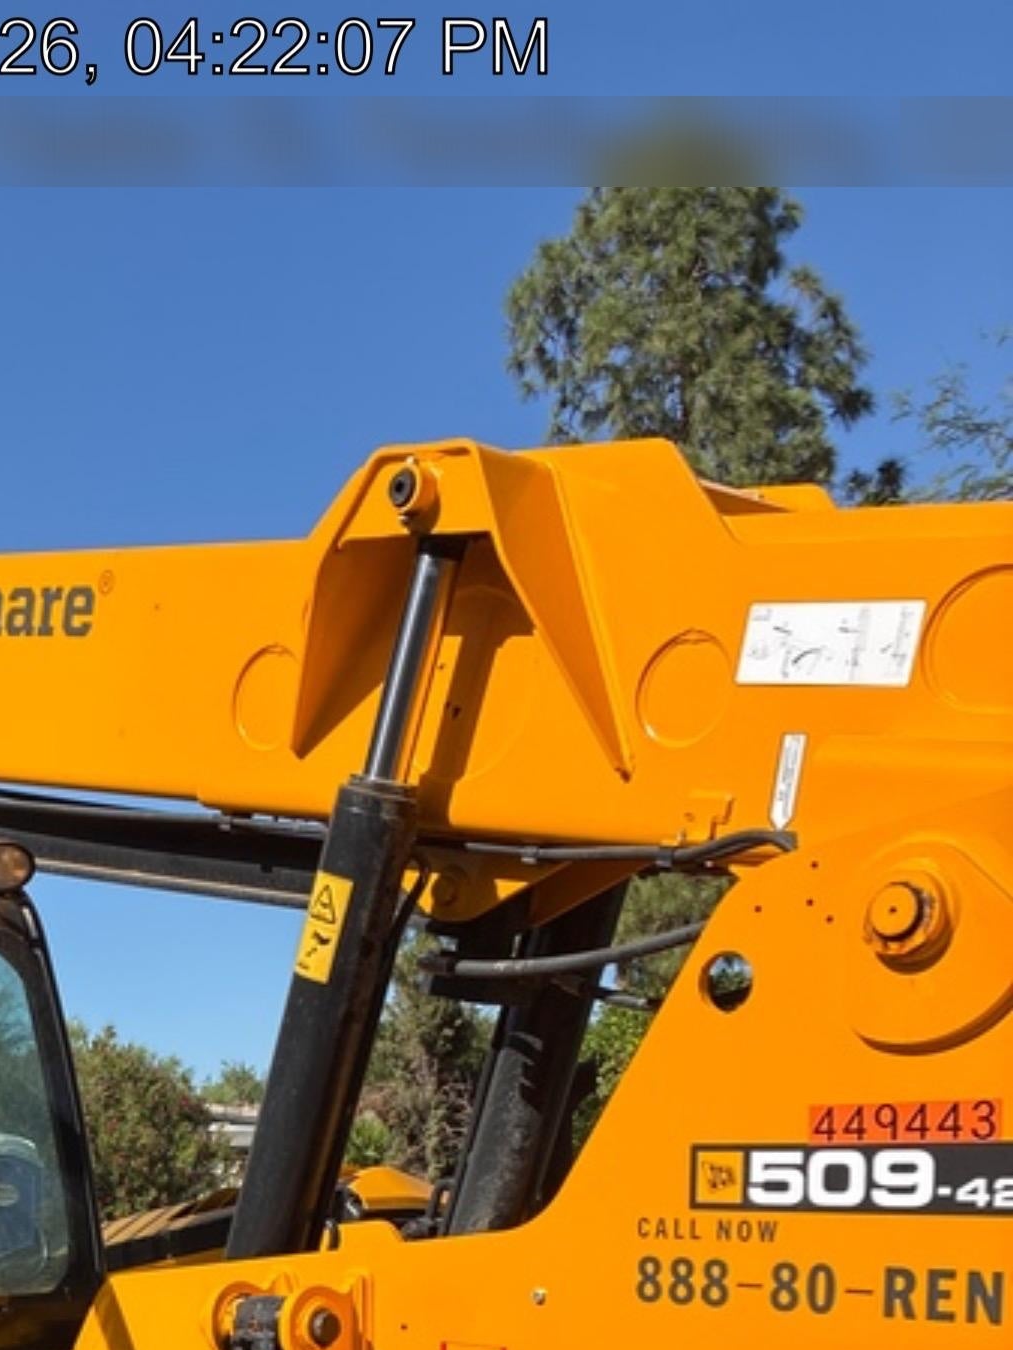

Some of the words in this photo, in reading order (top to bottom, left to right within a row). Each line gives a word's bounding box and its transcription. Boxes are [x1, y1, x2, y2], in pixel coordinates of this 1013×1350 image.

[813, 1100, 996, 1141] 449443
[637, 1217, 702, 1240] CALL
[716, 1220, 779, 1242] NOW
